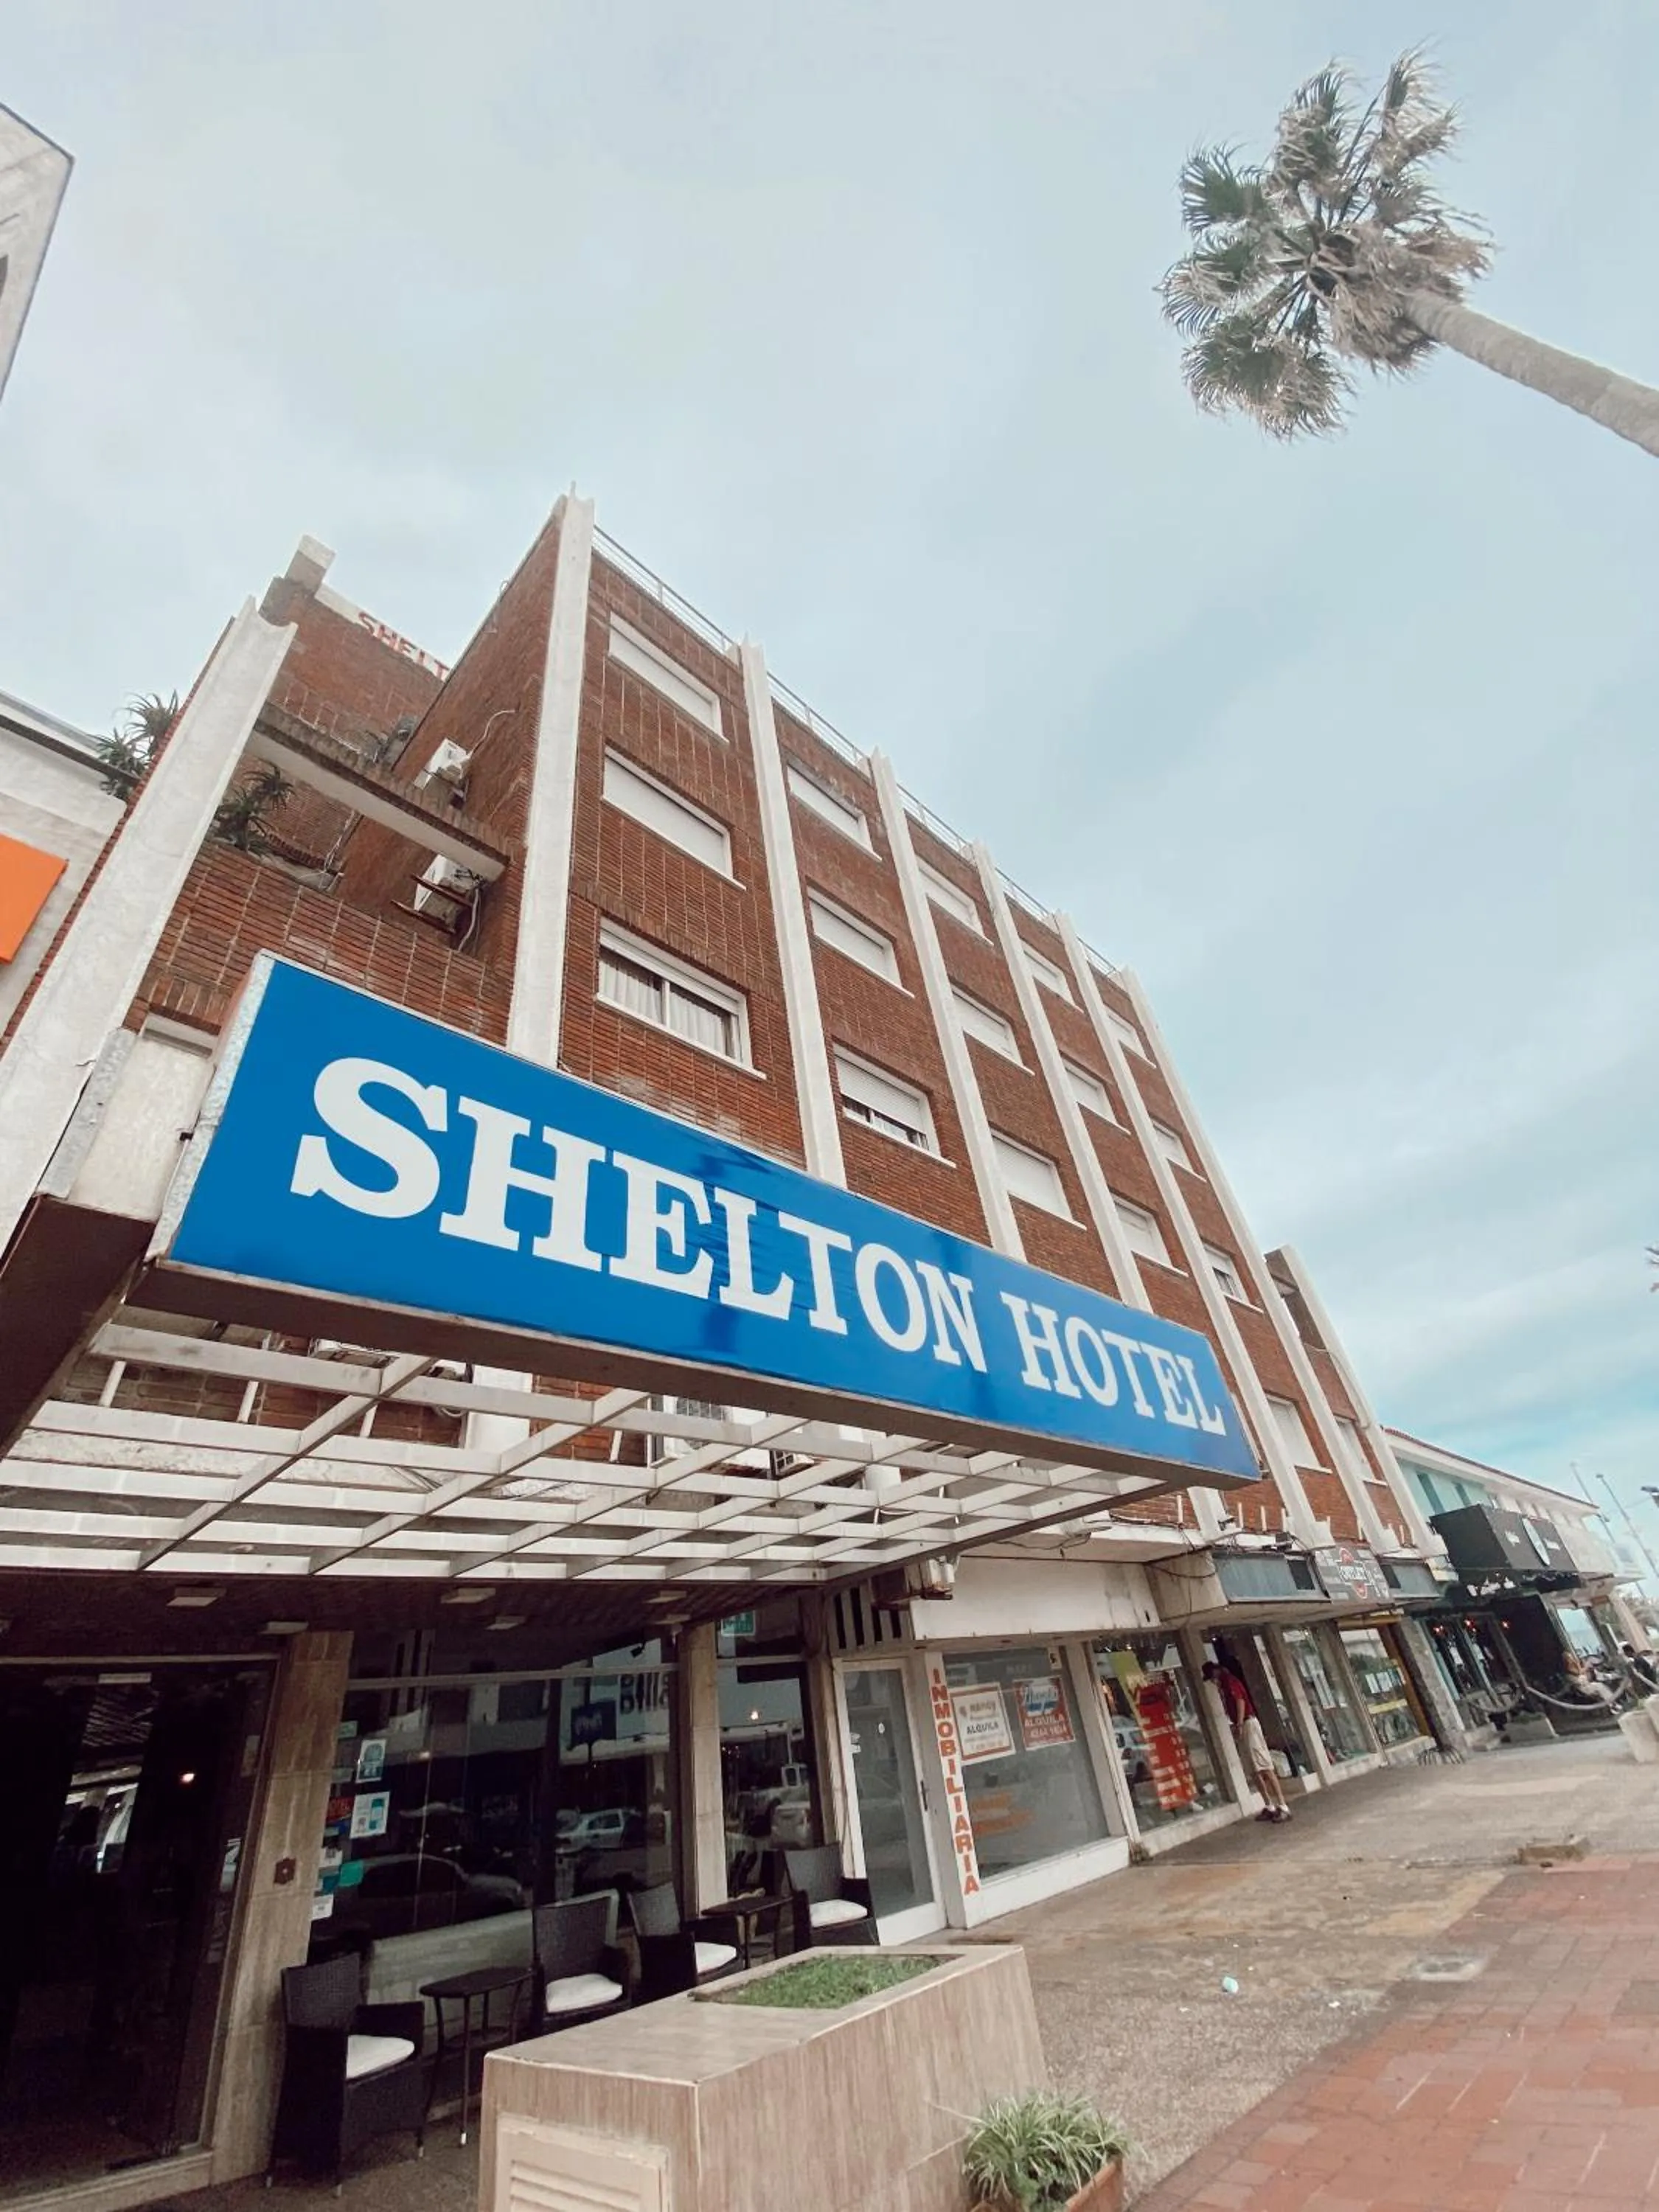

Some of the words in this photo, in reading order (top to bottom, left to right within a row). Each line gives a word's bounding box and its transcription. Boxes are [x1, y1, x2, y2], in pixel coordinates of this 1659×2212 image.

[291, 1057, 987, 1374] SHELTON
[1000, 1290, 1226, 1436] HOTEL
[967, 1721, 999, 1735] ALQUILA
[1024, 1713, 1065, 1727] ALQUILA
[930, 1668, 980, 1895] INMOBILIARIA
